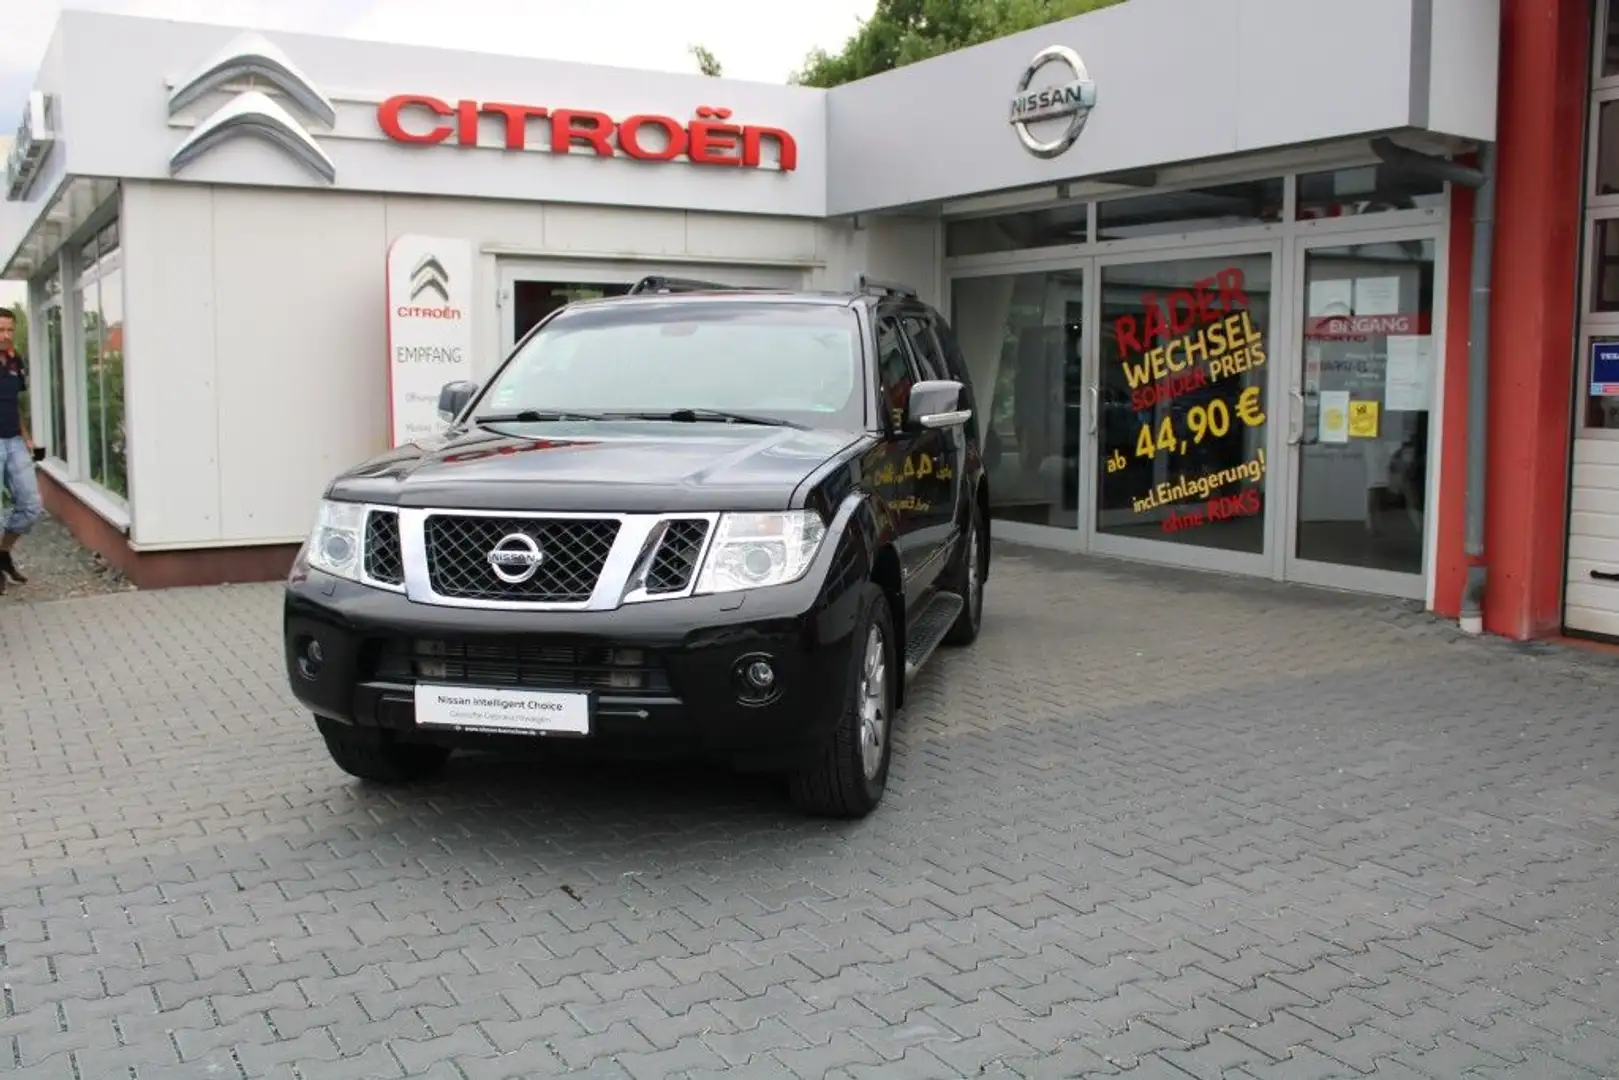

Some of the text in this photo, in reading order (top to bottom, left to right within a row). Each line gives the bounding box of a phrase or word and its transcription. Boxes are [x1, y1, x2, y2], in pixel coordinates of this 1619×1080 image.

[1011, 85, 1082, 116] NISSAN
[1115, 266, 1248, 358] RÄDER
[1329, 317, 1410, 334] EINGANG
[396, 345, 462, 363] EMPFANG
[1123, 311, 1262, 389] WECHSEL
[1131, 343, 1266, 412] SONDER PREIS
[1106, 386, 1266, 473] ab 44,90 €
[1206, 488, 1261, 522] RDKS
[491, 553, 536, 563] NISSAN
[437, 695, 563, 711] Nissan Intelligent Choice
